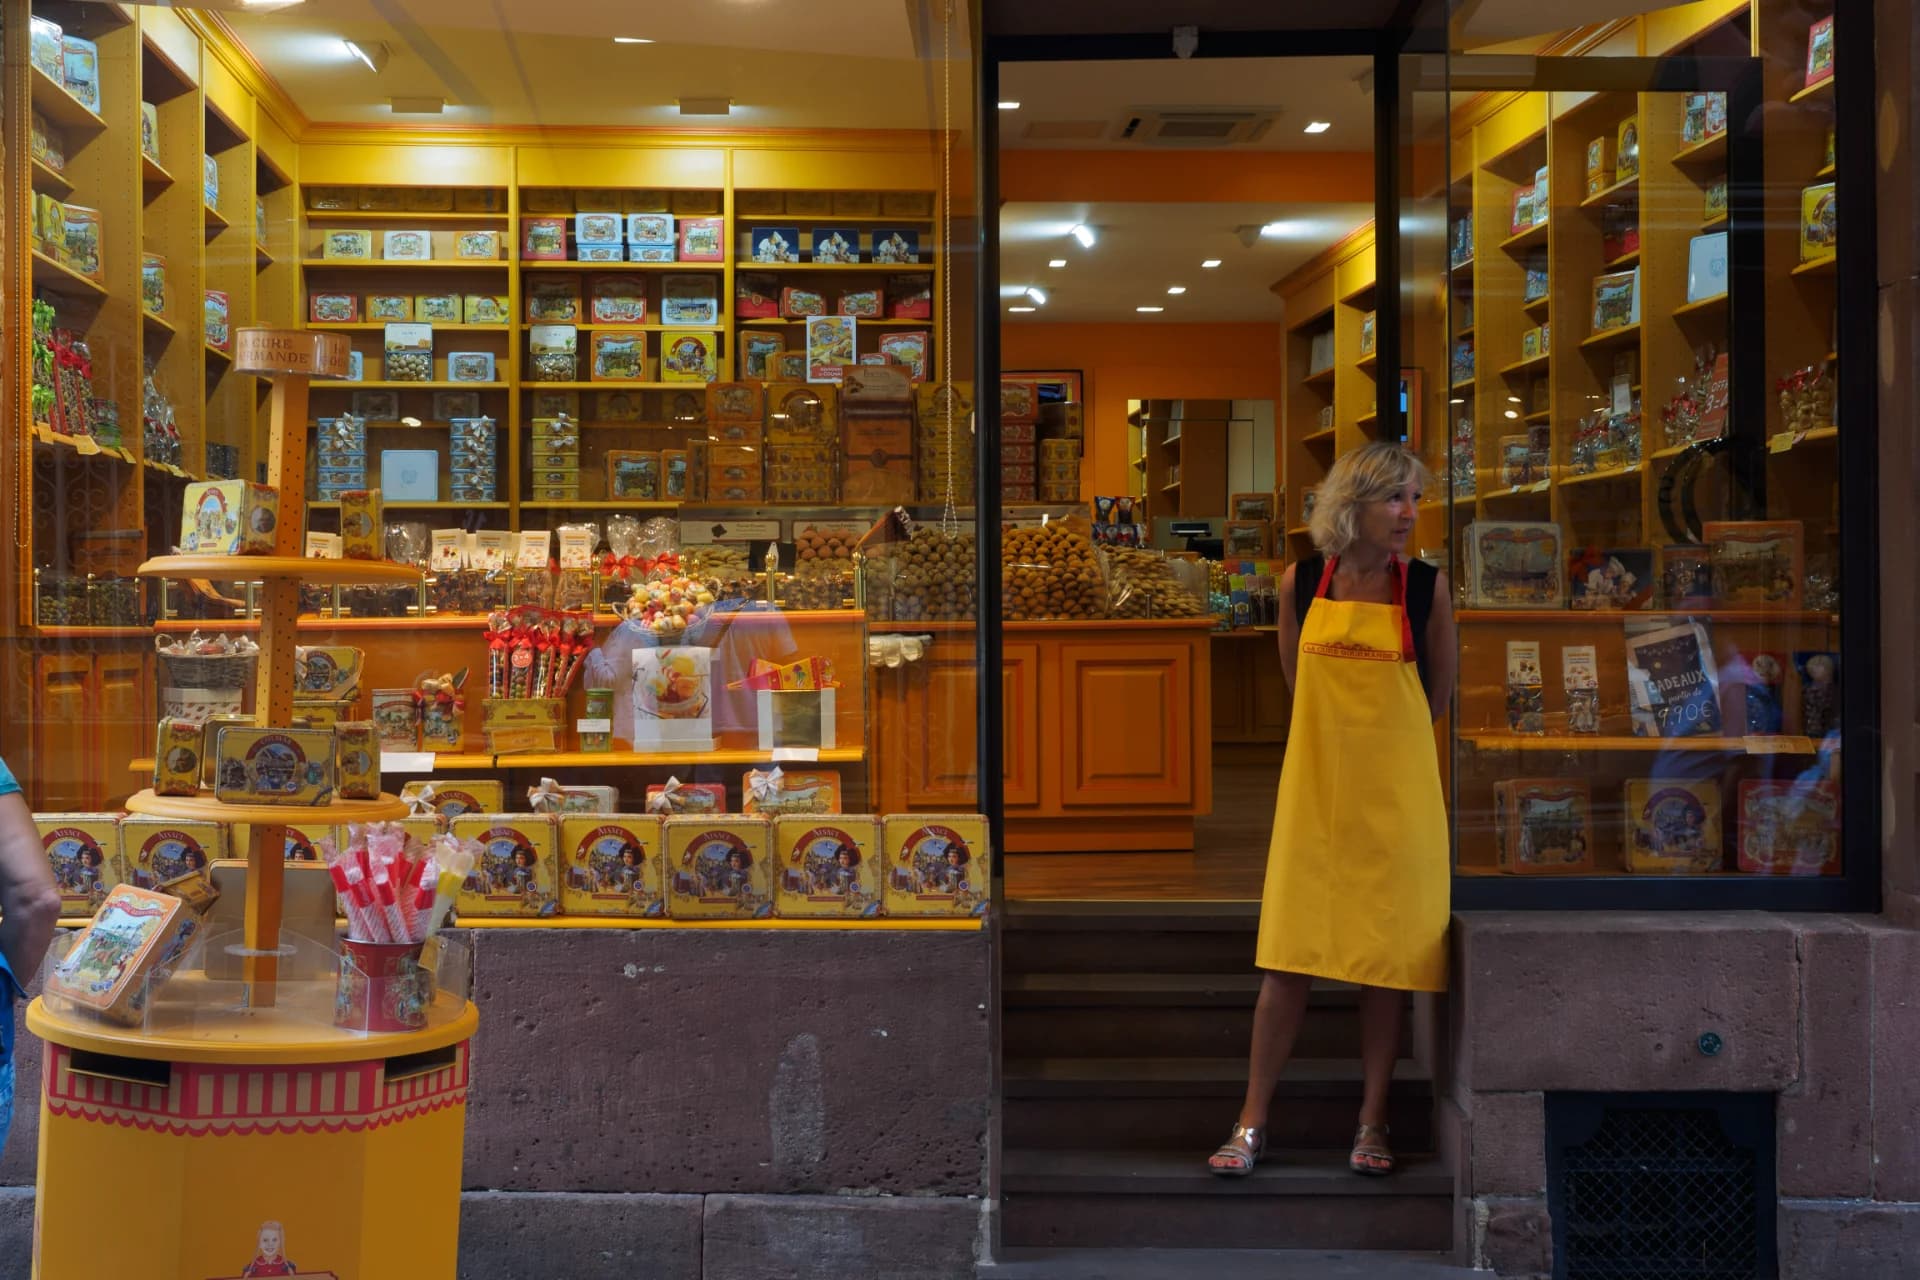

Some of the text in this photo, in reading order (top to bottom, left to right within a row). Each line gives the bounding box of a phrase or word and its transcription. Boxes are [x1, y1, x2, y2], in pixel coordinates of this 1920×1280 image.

[252, 336, 293, 349] CURE
[1648, 670, 1706, 693] CADEAUX
[55, 828, 81, 838] ALSACE
[159, 831, 185, 841] ALSACE
[598, 826, 625, 836] ALSACE
[812, 829, 840, 838] ALSACE
[703, 832, 731, 841] ALSACE
